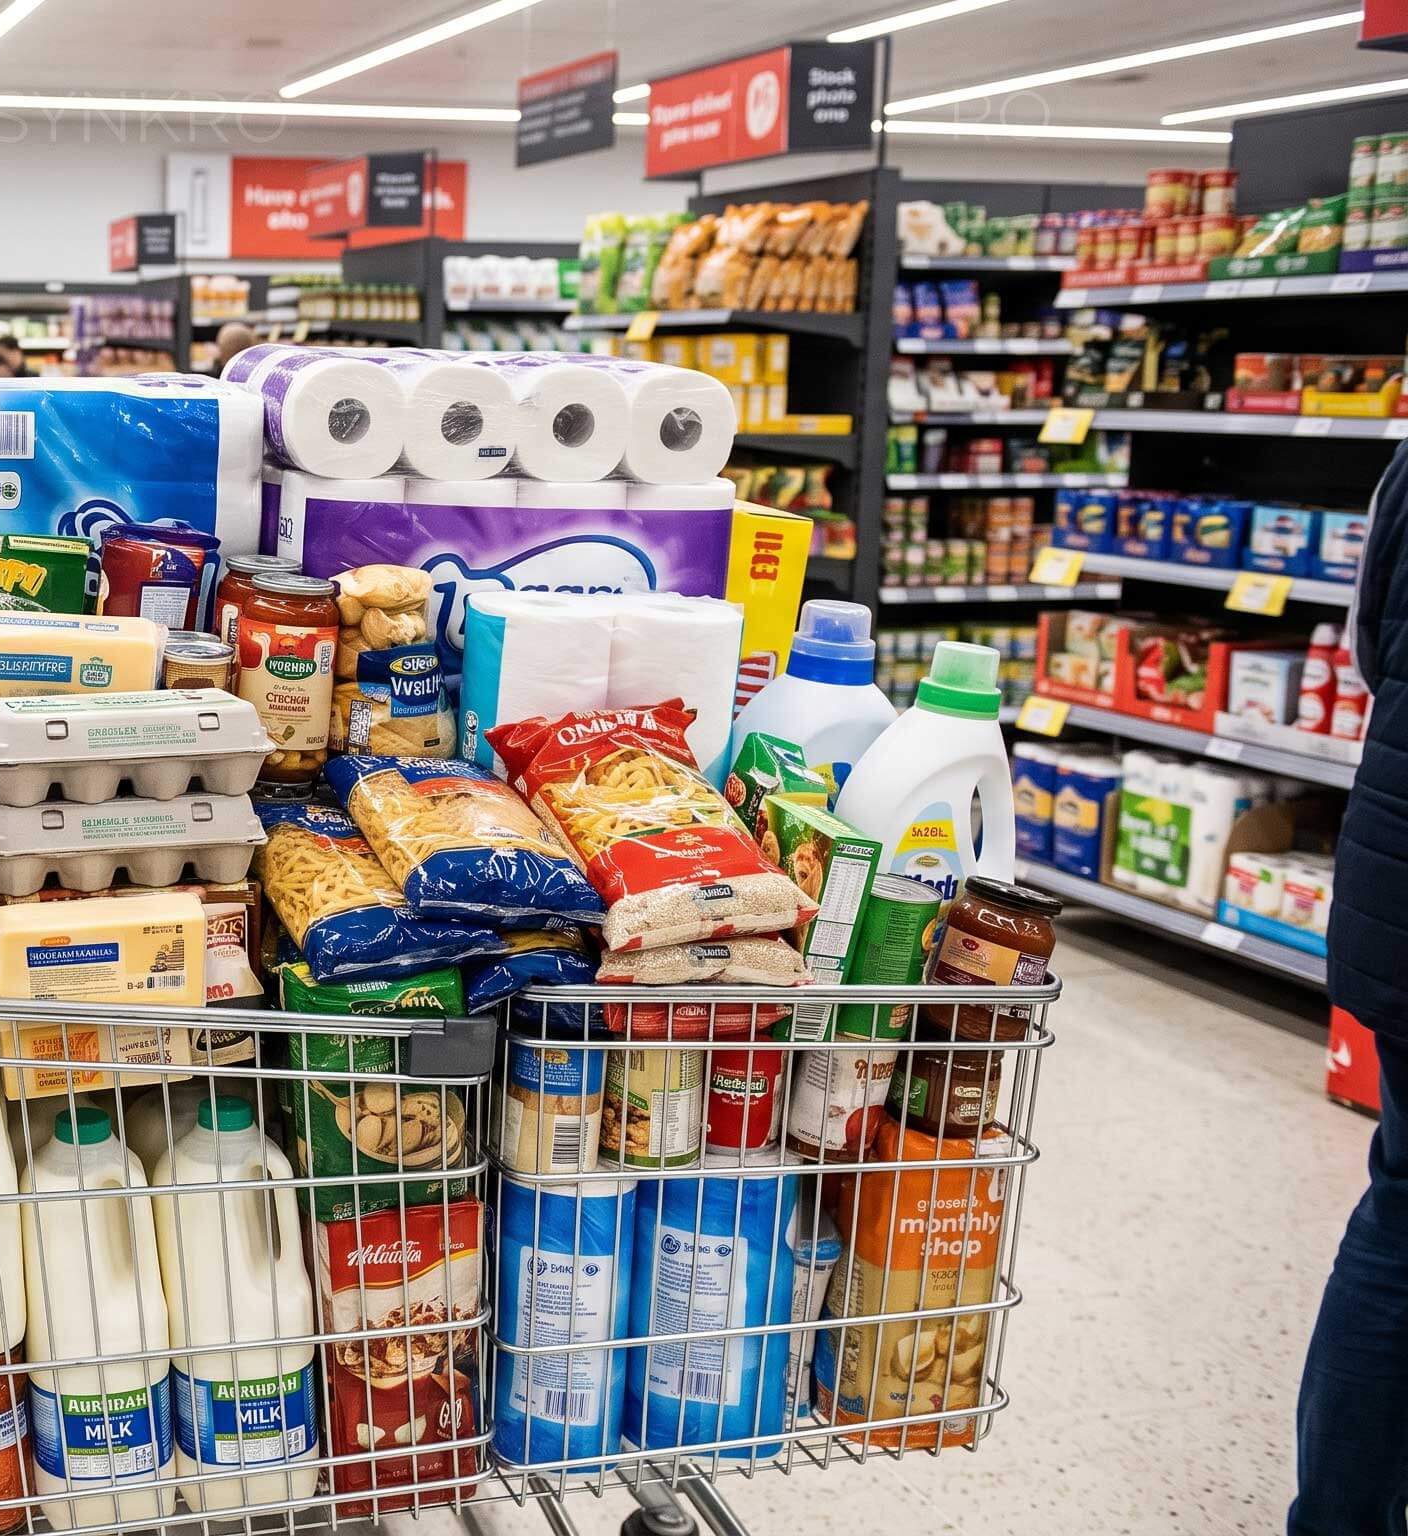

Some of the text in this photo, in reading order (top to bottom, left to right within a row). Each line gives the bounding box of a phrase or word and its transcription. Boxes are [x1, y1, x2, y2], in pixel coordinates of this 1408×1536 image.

[898, 1211, 1002, 1236] monthly
[920, 1237, 983, 1259] shop
[238, 1405, 282, 1425] MILK
[85, 1420, 134, 1441] MILK
